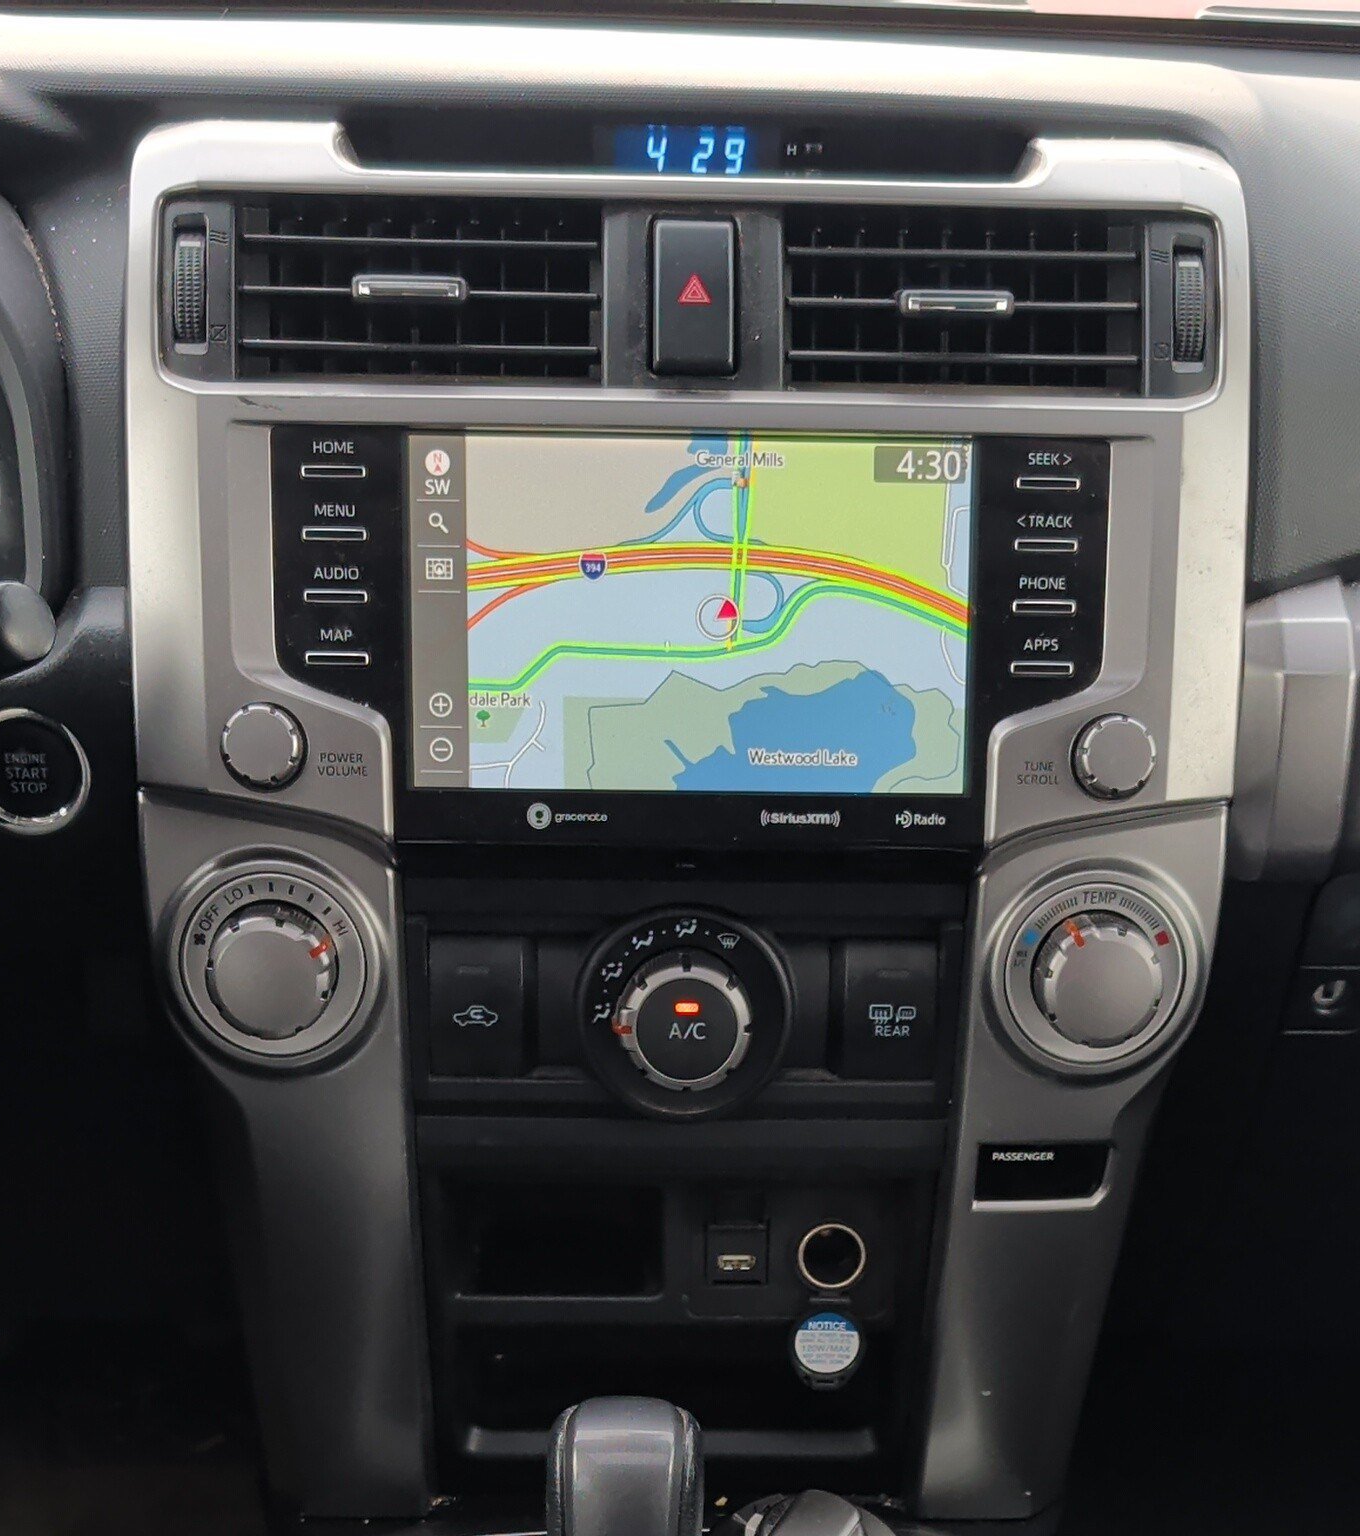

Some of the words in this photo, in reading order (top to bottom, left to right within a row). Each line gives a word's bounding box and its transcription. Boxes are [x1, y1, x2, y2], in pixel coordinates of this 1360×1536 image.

[312, 441, 354, 455] HOME
[433, 452, 442, 463] N
[697, 452, 748, 467] General
[753, 452, 784, 467] Mills
[896, 450, 961, 481] 4:30
[425, 479, 451, 495] SW
[314, 504, 355, 518] MENU
[313, 567, 359, 580] AUDIO
[585, 563, 601, 574] 394
[1019, 577, 1066, 590] PHONE
[320, 628, 353, 642] MAP
[1023, 638, 1059, 652] APPS
[501, 693, 531, 707] Park
[320, 753, 363, 764] POWER
[748, 749, 821, 765] Westwood
[823, 749, 857, 765] Lake
[5, 767, 48, 779] START
[317, 765, 368, 777] VOLUME
[1024, 762, 1054, 773] TUNE
[1016, 774, 1059, 786] SCROLL
[11, 782, 47, 793] STOP
[554, 812, 608, 823] gracenote
[914, 813, 946, 826] Radio
[224, 888, 243, 905] LO
[1082, 891, 1117, 904] TEMP
[198, 904, 220, 932] OFF
[669, 1022, 706, 1040] A/C
[875, 1025, 910, 1037] REAR
[992, 1152, 1055, 1161] PASSENGER
[808, 1321, 847, 1331] NOTICE
